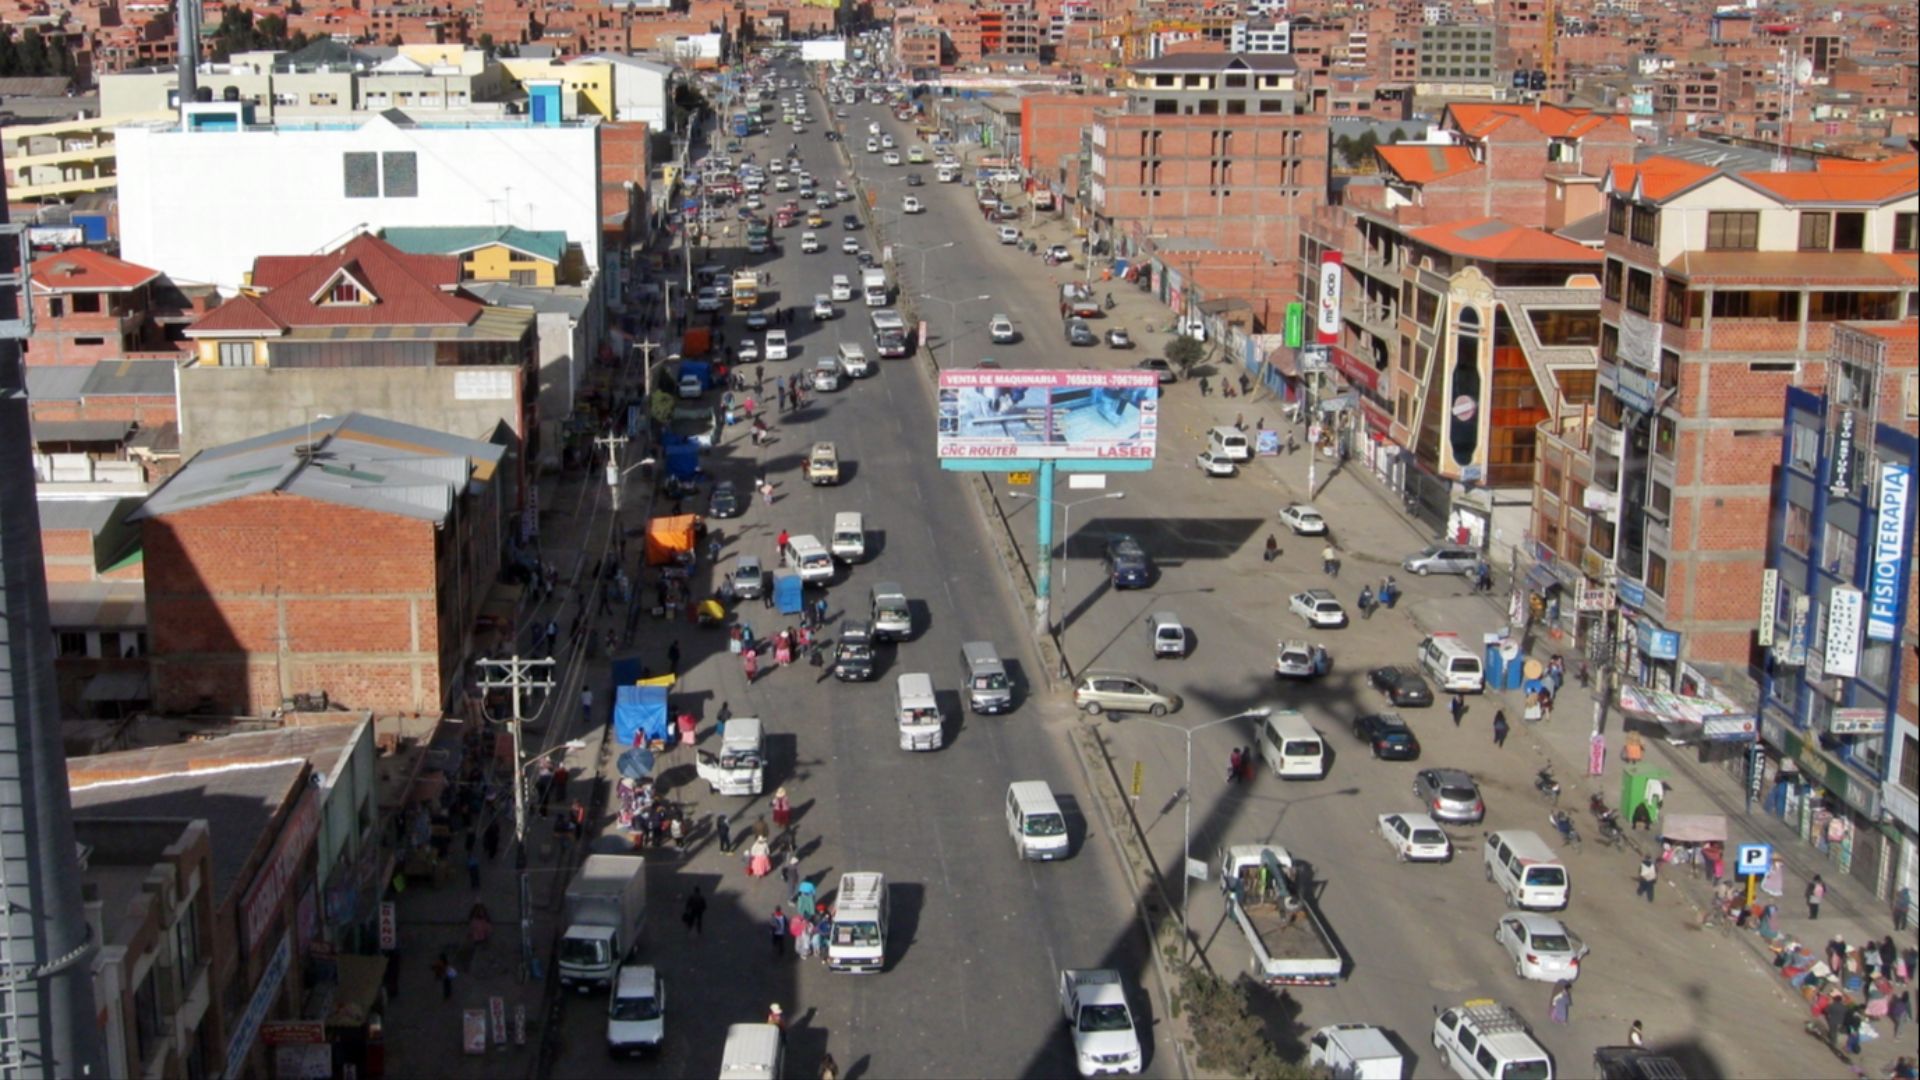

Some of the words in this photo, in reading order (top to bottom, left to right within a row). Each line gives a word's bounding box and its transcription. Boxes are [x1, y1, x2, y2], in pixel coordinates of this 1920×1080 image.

[946, 375, 977, 384] VENTA
[980, 375, 993, 384] DE
[995, 375, 1058, 384] MAQUINARIA
[941, 446, 966, 456] CNC
[969, 446, 1018, 456] ROUTER
[1097, 447, 1152, 457] LASER
[1872, 467, 1905, 617] FISIOTERAPIA
[1747, 849, 1762, 864] P
